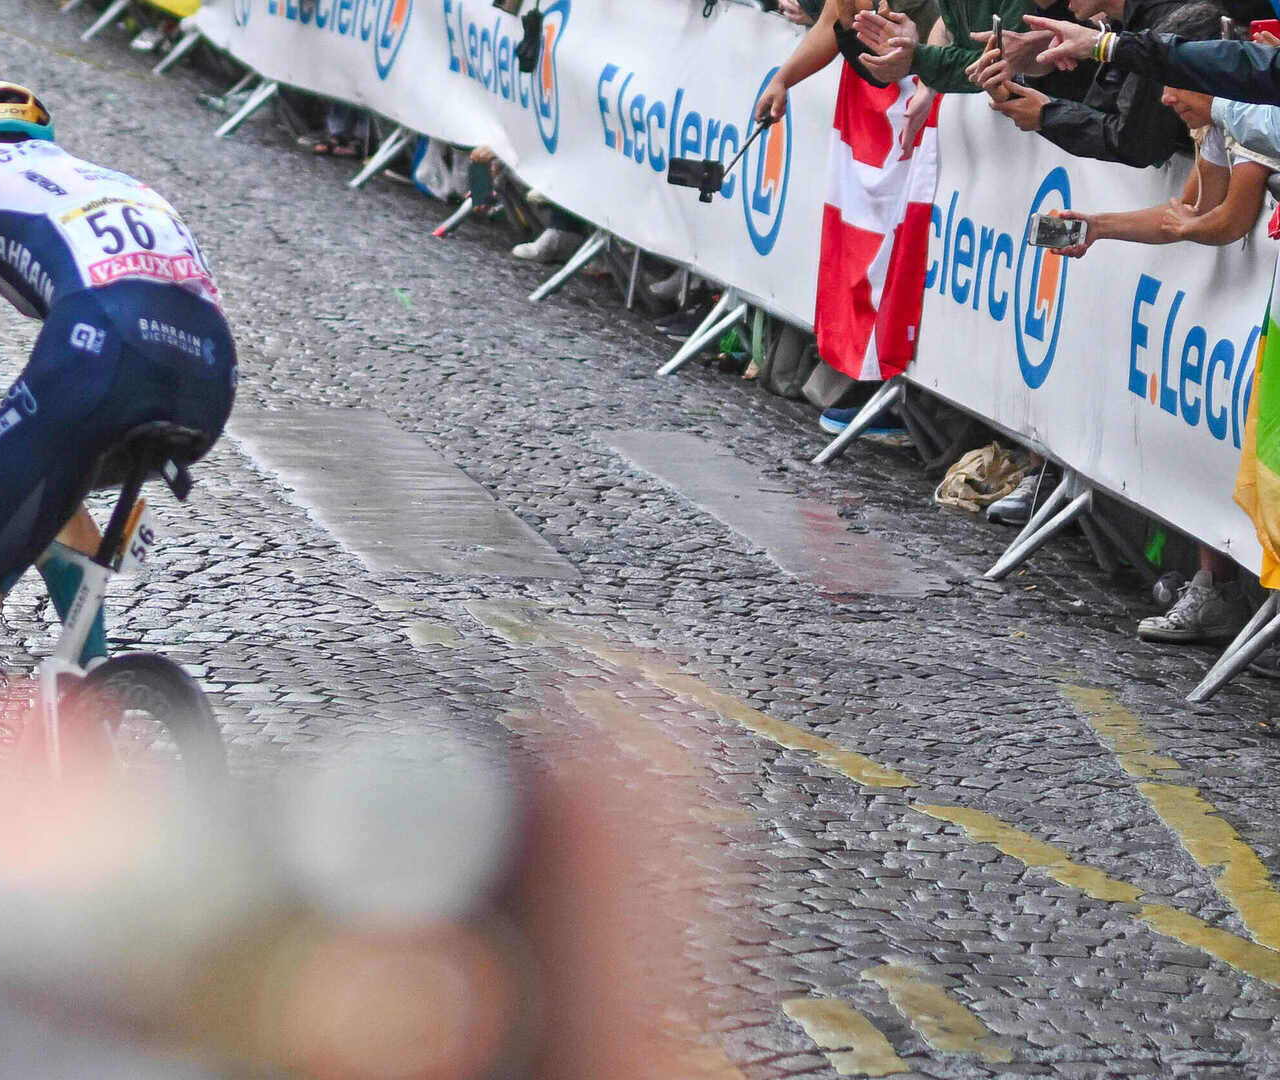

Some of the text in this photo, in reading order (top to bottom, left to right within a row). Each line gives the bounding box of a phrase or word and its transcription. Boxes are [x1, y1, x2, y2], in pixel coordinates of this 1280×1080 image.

[85, 205, 156, 255] 56
[93, 254, 172, 281] VELUX
[139, 318, 201, 348] BAHRAIN
[130, 523, 154, 563] 56
